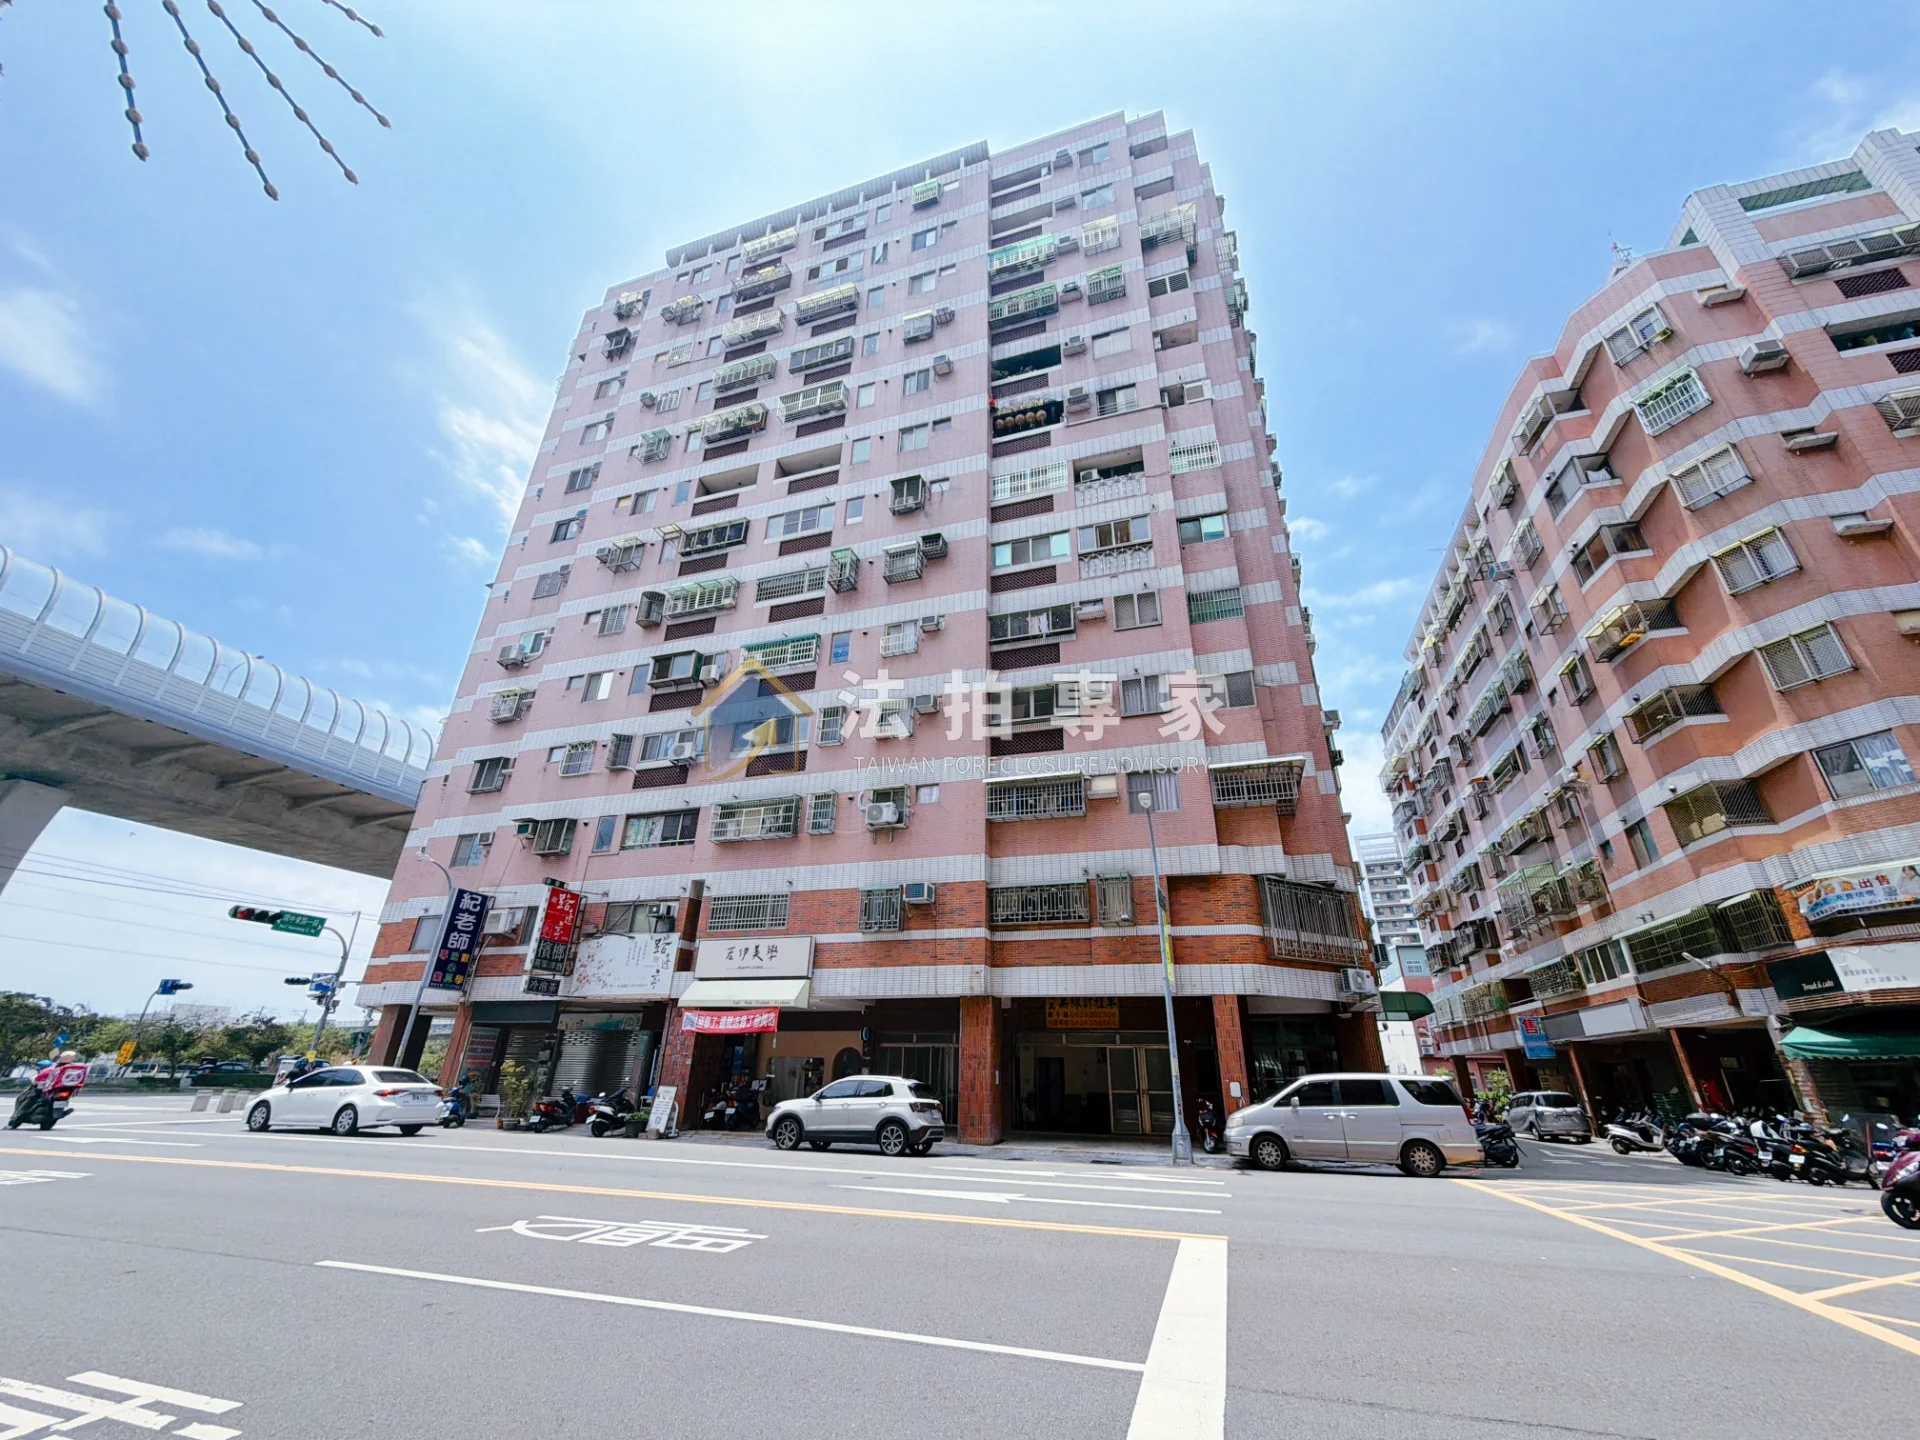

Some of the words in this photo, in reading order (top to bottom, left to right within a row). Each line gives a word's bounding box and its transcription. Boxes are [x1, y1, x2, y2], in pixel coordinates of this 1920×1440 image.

[447, 892, 483, 951] 紀老師
[537, 939, 566, 960] 檳榔
[529, 978, 557, 992] 冷泡茶
